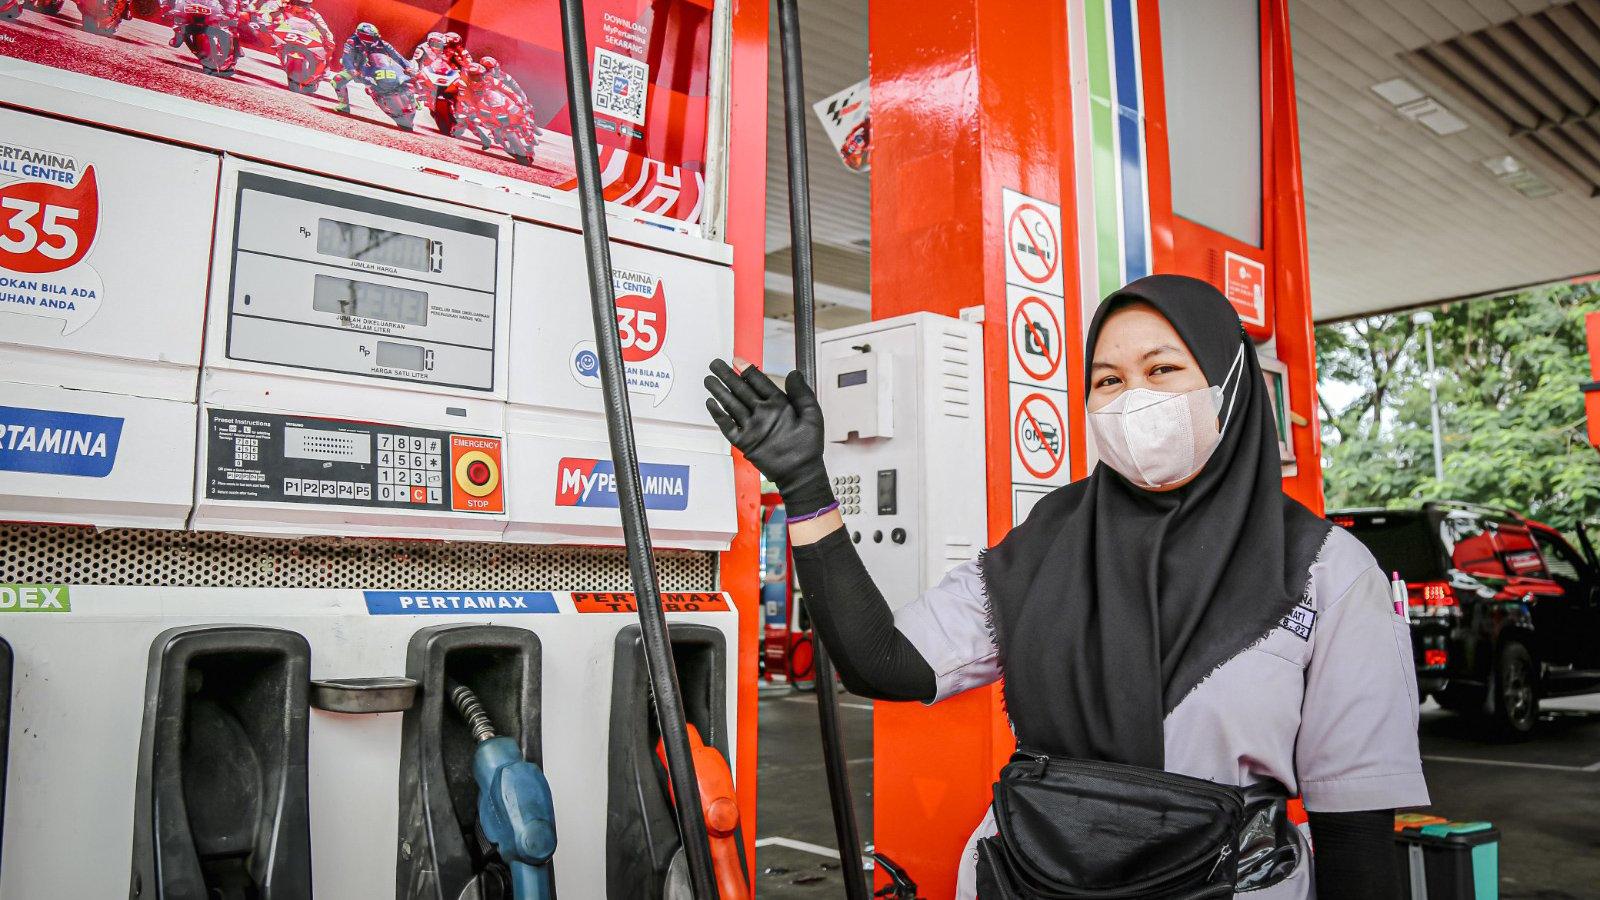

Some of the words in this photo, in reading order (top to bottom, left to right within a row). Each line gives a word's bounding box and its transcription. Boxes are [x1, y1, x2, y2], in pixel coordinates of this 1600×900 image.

[604, 13, 647, 34] DOWNLOAD
[603, 23, 646, 44] MyPertamina
[605, 35, 642, 54] SEKARANG
[22, 164, 74, 184] CENTER
[0, 196, 79, 260] 35
[350, 261, 375, 270] JUMLAH
[376, 265, 398, 274] HARGA
[0, 278, 37, 291] OKAN
[41, 283, 67, 296] BILA
[71, 288, 96, 299] ADA
[622, 281, 652, 294] CENTER
[39, 298, 75, 311] ANDA
[350, 323, 372, 331] DALAM
[374, 326, 391, 334] LITER
[363, 318, 405, 330] DIKELUARKAN
[616, 307, 658, 352] 35
[371, 367, 392, 375] HARGA
[395, 369, 410, 377] SATU
[411, 371, 429, 379] LITER
[640, 368, 654, 377] BILA
[656, 370, 670, 379] ADA
[639, 379, 660, 388] ANDA
[235, 418, 271, 427] Instructions
[382, 437, 389, 448] 7
[398, 438, 405, 449] 8
[414, 440, 422, 450] 9
[453, 438, 498, 449] EMERGENCY
[381, 453, 389, 464] 4
[398, 455, 405, 465] 5
[414, 456, 422, 467] 6
[383, 470, 388, 481] 1
[398, 471, 406, 482] 2
[414, 472, 422, 484] 3
[285, 481, 299, 492] P1
[303, 483, 318, 493] P2
[321, 484, 335, 494] P3
[339, 485, 353, 495] P4
[356, 486, 370, 496] P5
[382, 487, 390, 499] 0
[414, 489, 423, 500] C
[431, 490, 438, 501] L
[467, 499, 489, 508] STOP
[0, 586, 63, 609] DEX
[399, 596, 528, 609] PERTAMAX
[574, 592, 722, 603] PERMAX
